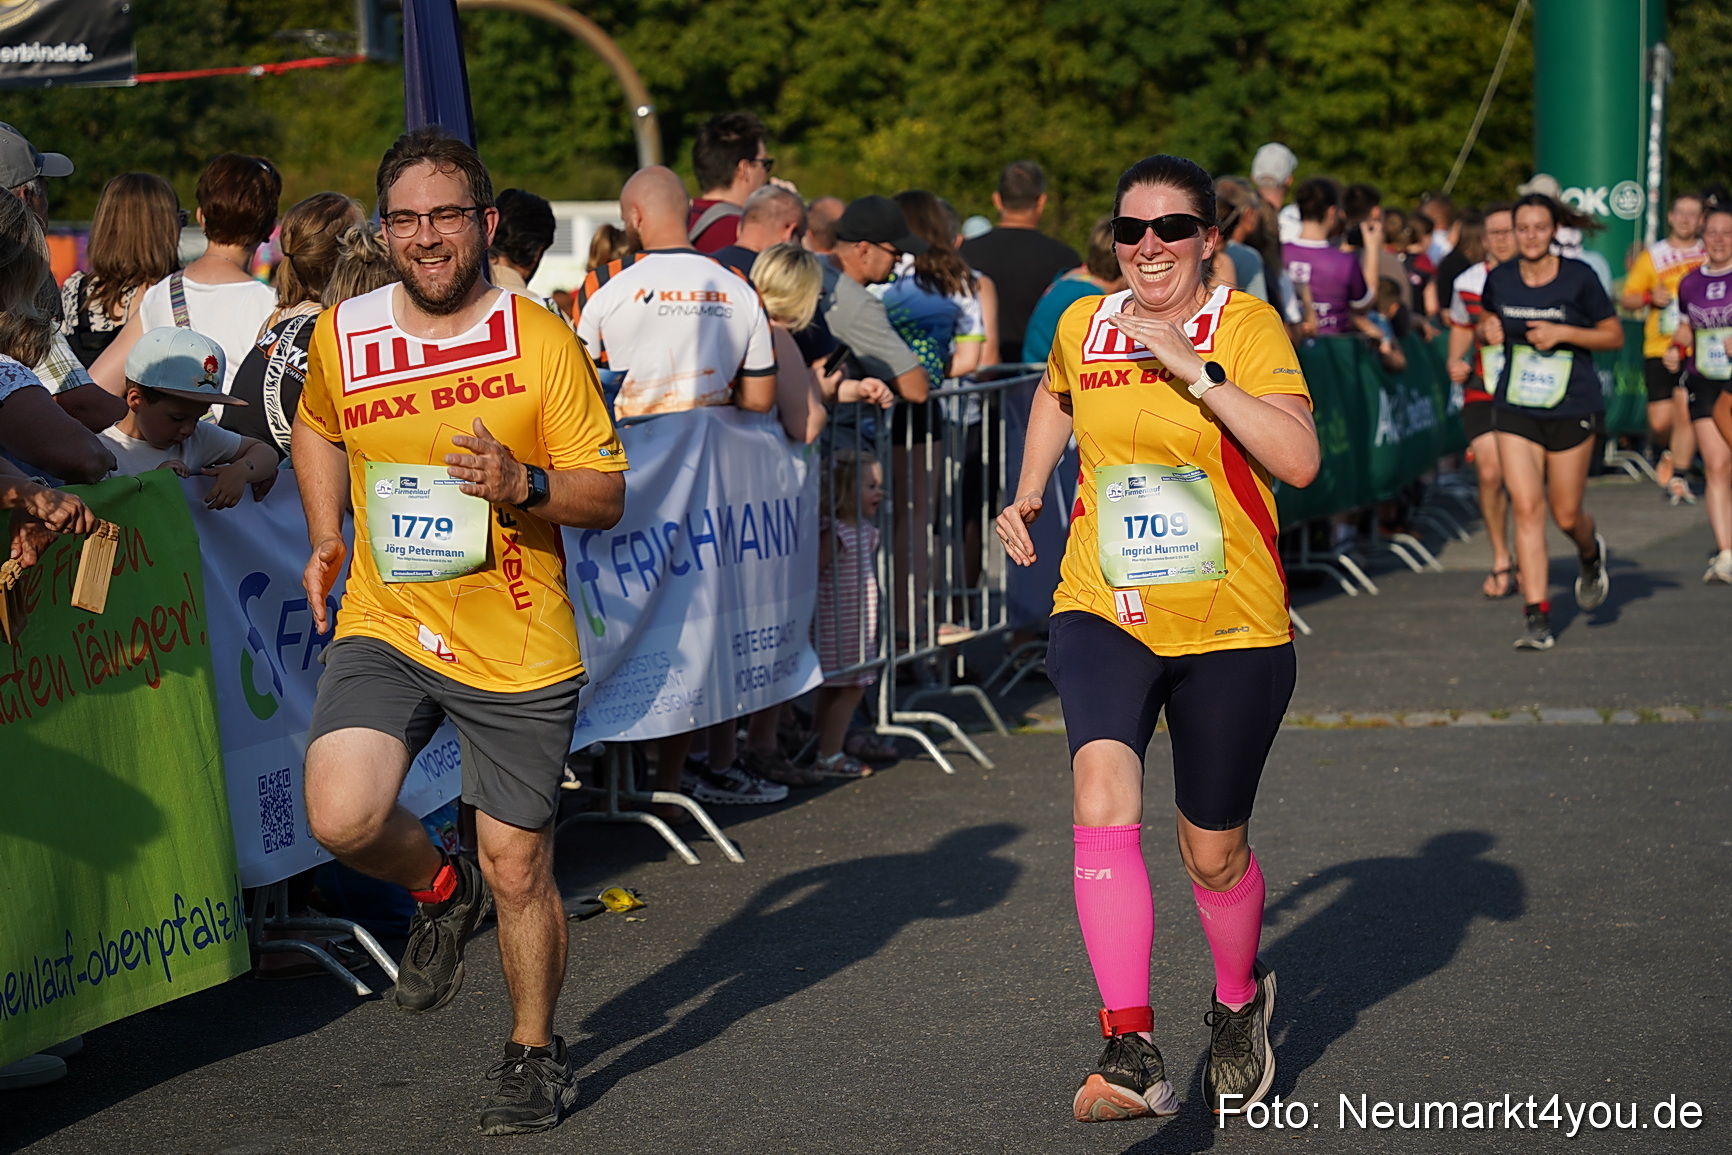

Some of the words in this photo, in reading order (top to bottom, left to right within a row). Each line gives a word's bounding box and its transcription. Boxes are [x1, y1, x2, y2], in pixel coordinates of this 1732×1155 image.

[660, 290, 732, 304] KLEBL
[657, 304, 734, 319] DYNAMICS
[1080, 369, 1132, 391] MAX
[343, 393, 421, 430] MAX
[431, 373, 526, 411] BÖGL
[394, 488, 431, 496] Firmenlauf
[391, 514, 453, 541] 1779
[1123, 512, 1189, 539] 1709
[385, 544, 405, 556] Jörg
[408, 545, 465, 558] Petermann
[611, 497, 800, 597] FRICHMANN
[1121, 546, 1152, 558] Ingrid
[1155, 542, 1199, 554] Hummel
[0, 638, 76, 726] ufen
[72, 572, 205, 690] länger!
[598, 697, 661, 725] CORPORATE
